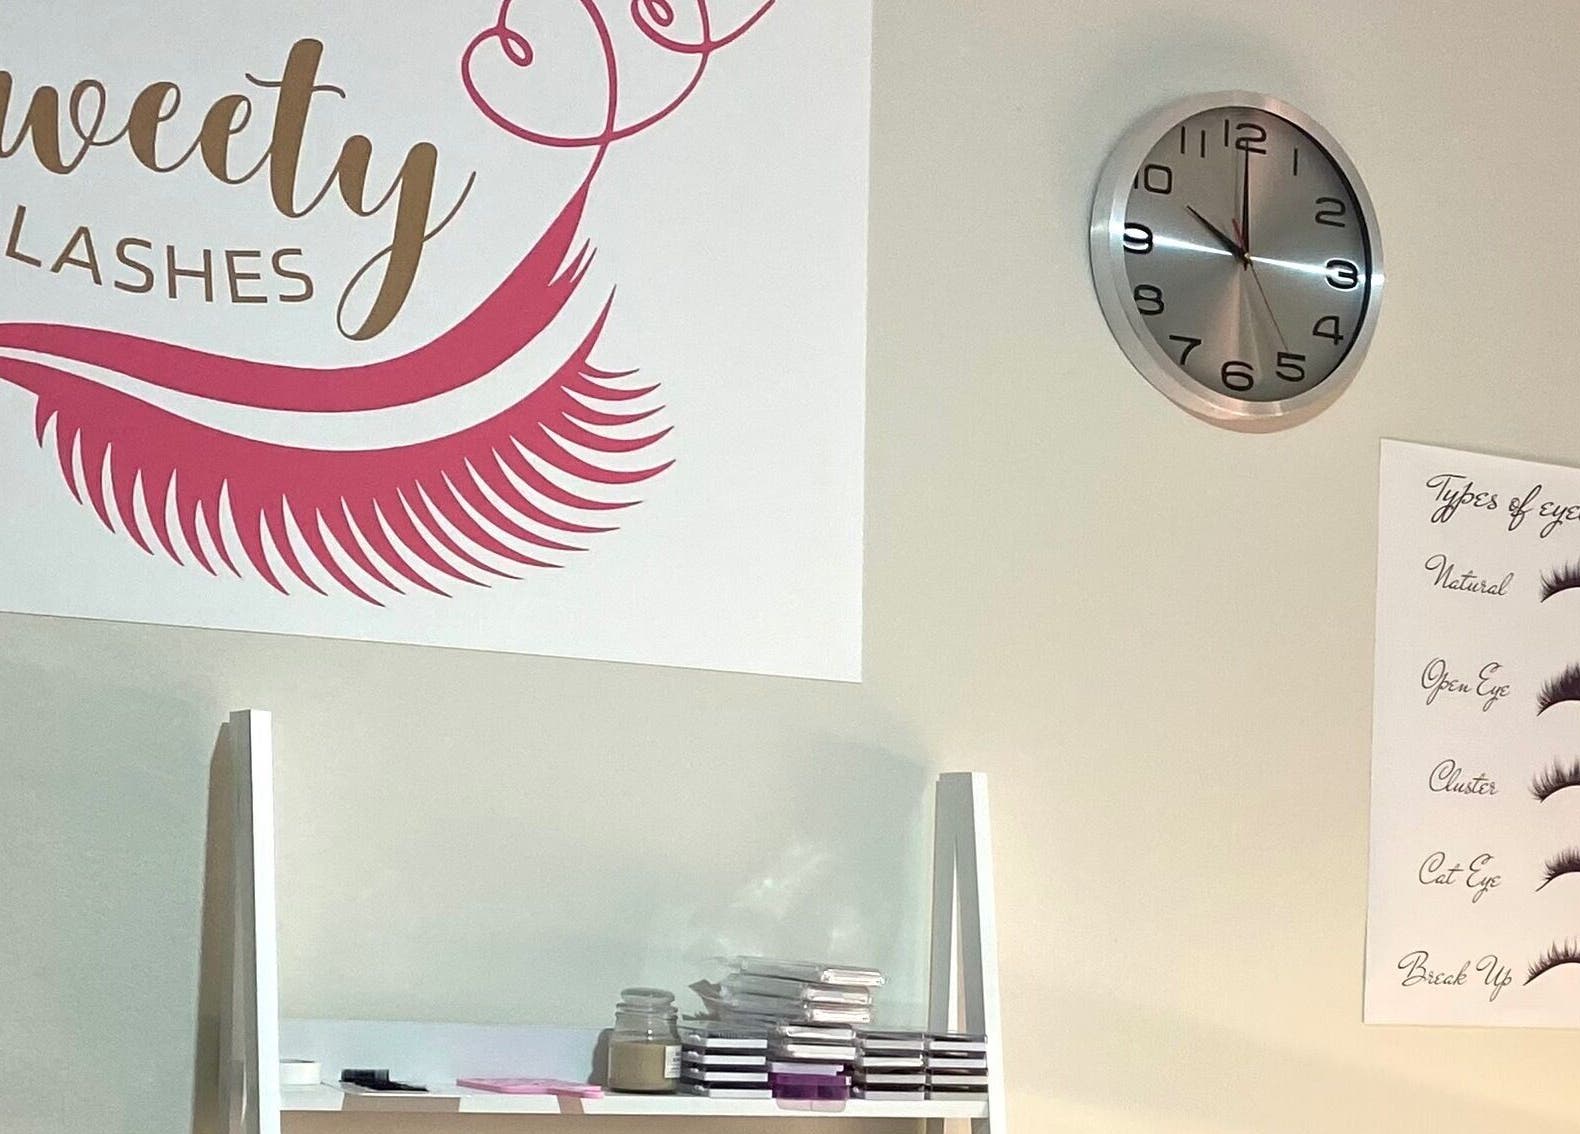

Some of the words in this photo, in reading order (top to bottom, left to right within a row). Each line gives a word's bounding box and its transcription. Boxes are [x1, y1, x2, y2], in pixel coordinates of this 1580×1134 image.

[1179, 125, 1207, 158] 11
[1223, 119, 1267, 155] 12
[1292, 147, 1300, 177] 1
[1314, 196, 1347, 228] 2
[4, 204, 315, 305] LASHES
[1123, 221, 1154, 256] 9
[1324, 258, 1359, 291] 3
[1133, 283, 1165, 316] 8
[1312, 315, 1345, 346] 4
[1169, 334, 1202, 366] 7
[1275, 351, 1307, 383] 5
[1220, 360, 1255, 392] 6
[1426, 474, 1499, 524] Types
[1508, 484, 1543, 532] of
[1425, 554, 1515, 597] Natural
[1421, 657, 1472, 704] Open
[1476, 661, 1512, 711] Eye
[1428, 758, 1500, 798] Cluster
[1418, 852, 1461, 888] Cat
[1466, 853, 1502, 903] Eye
[1398, 949, 1468, 988] Break
[1476, 955, 1513, 1002] Up
